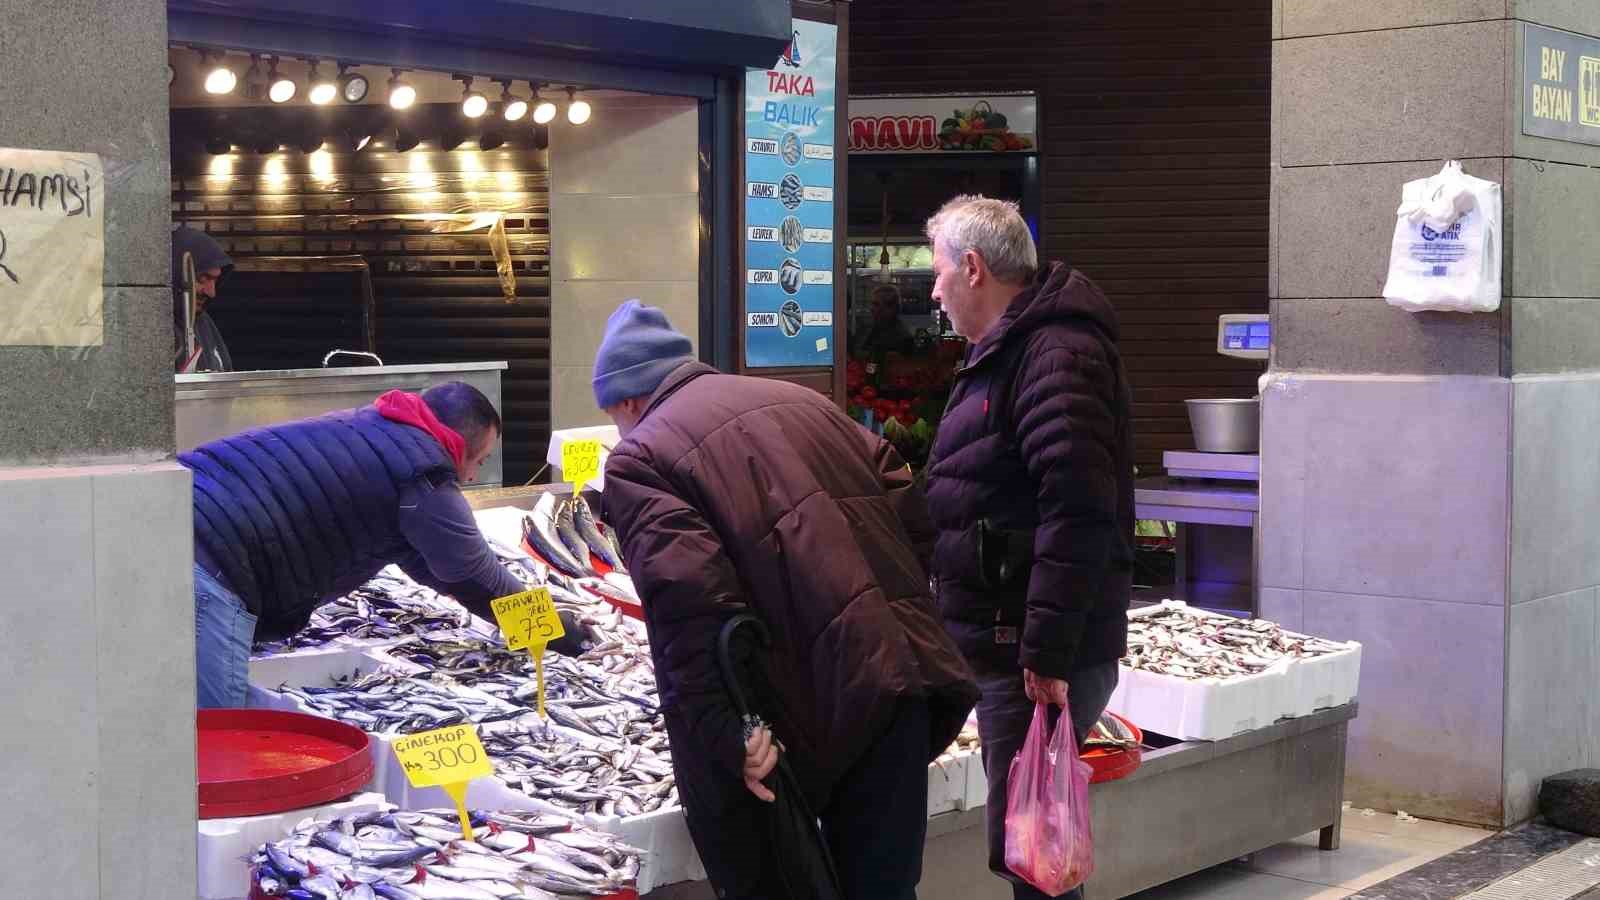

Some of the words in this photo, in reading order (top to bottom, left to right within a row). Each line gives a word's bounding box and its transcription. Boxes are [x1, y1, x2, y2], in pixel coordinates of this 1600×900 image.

[1541, 46, 1566, 82] BAY
[766, 70, 817, 97] TAKA
[763, 101, 820, 127] BALIK
[1533, 84, 1572, 122] BAYAN
[848, 115, 937, 151] NAVI
[519, 615, 554, 641] 75
[423, 743, 477, 771] 300
